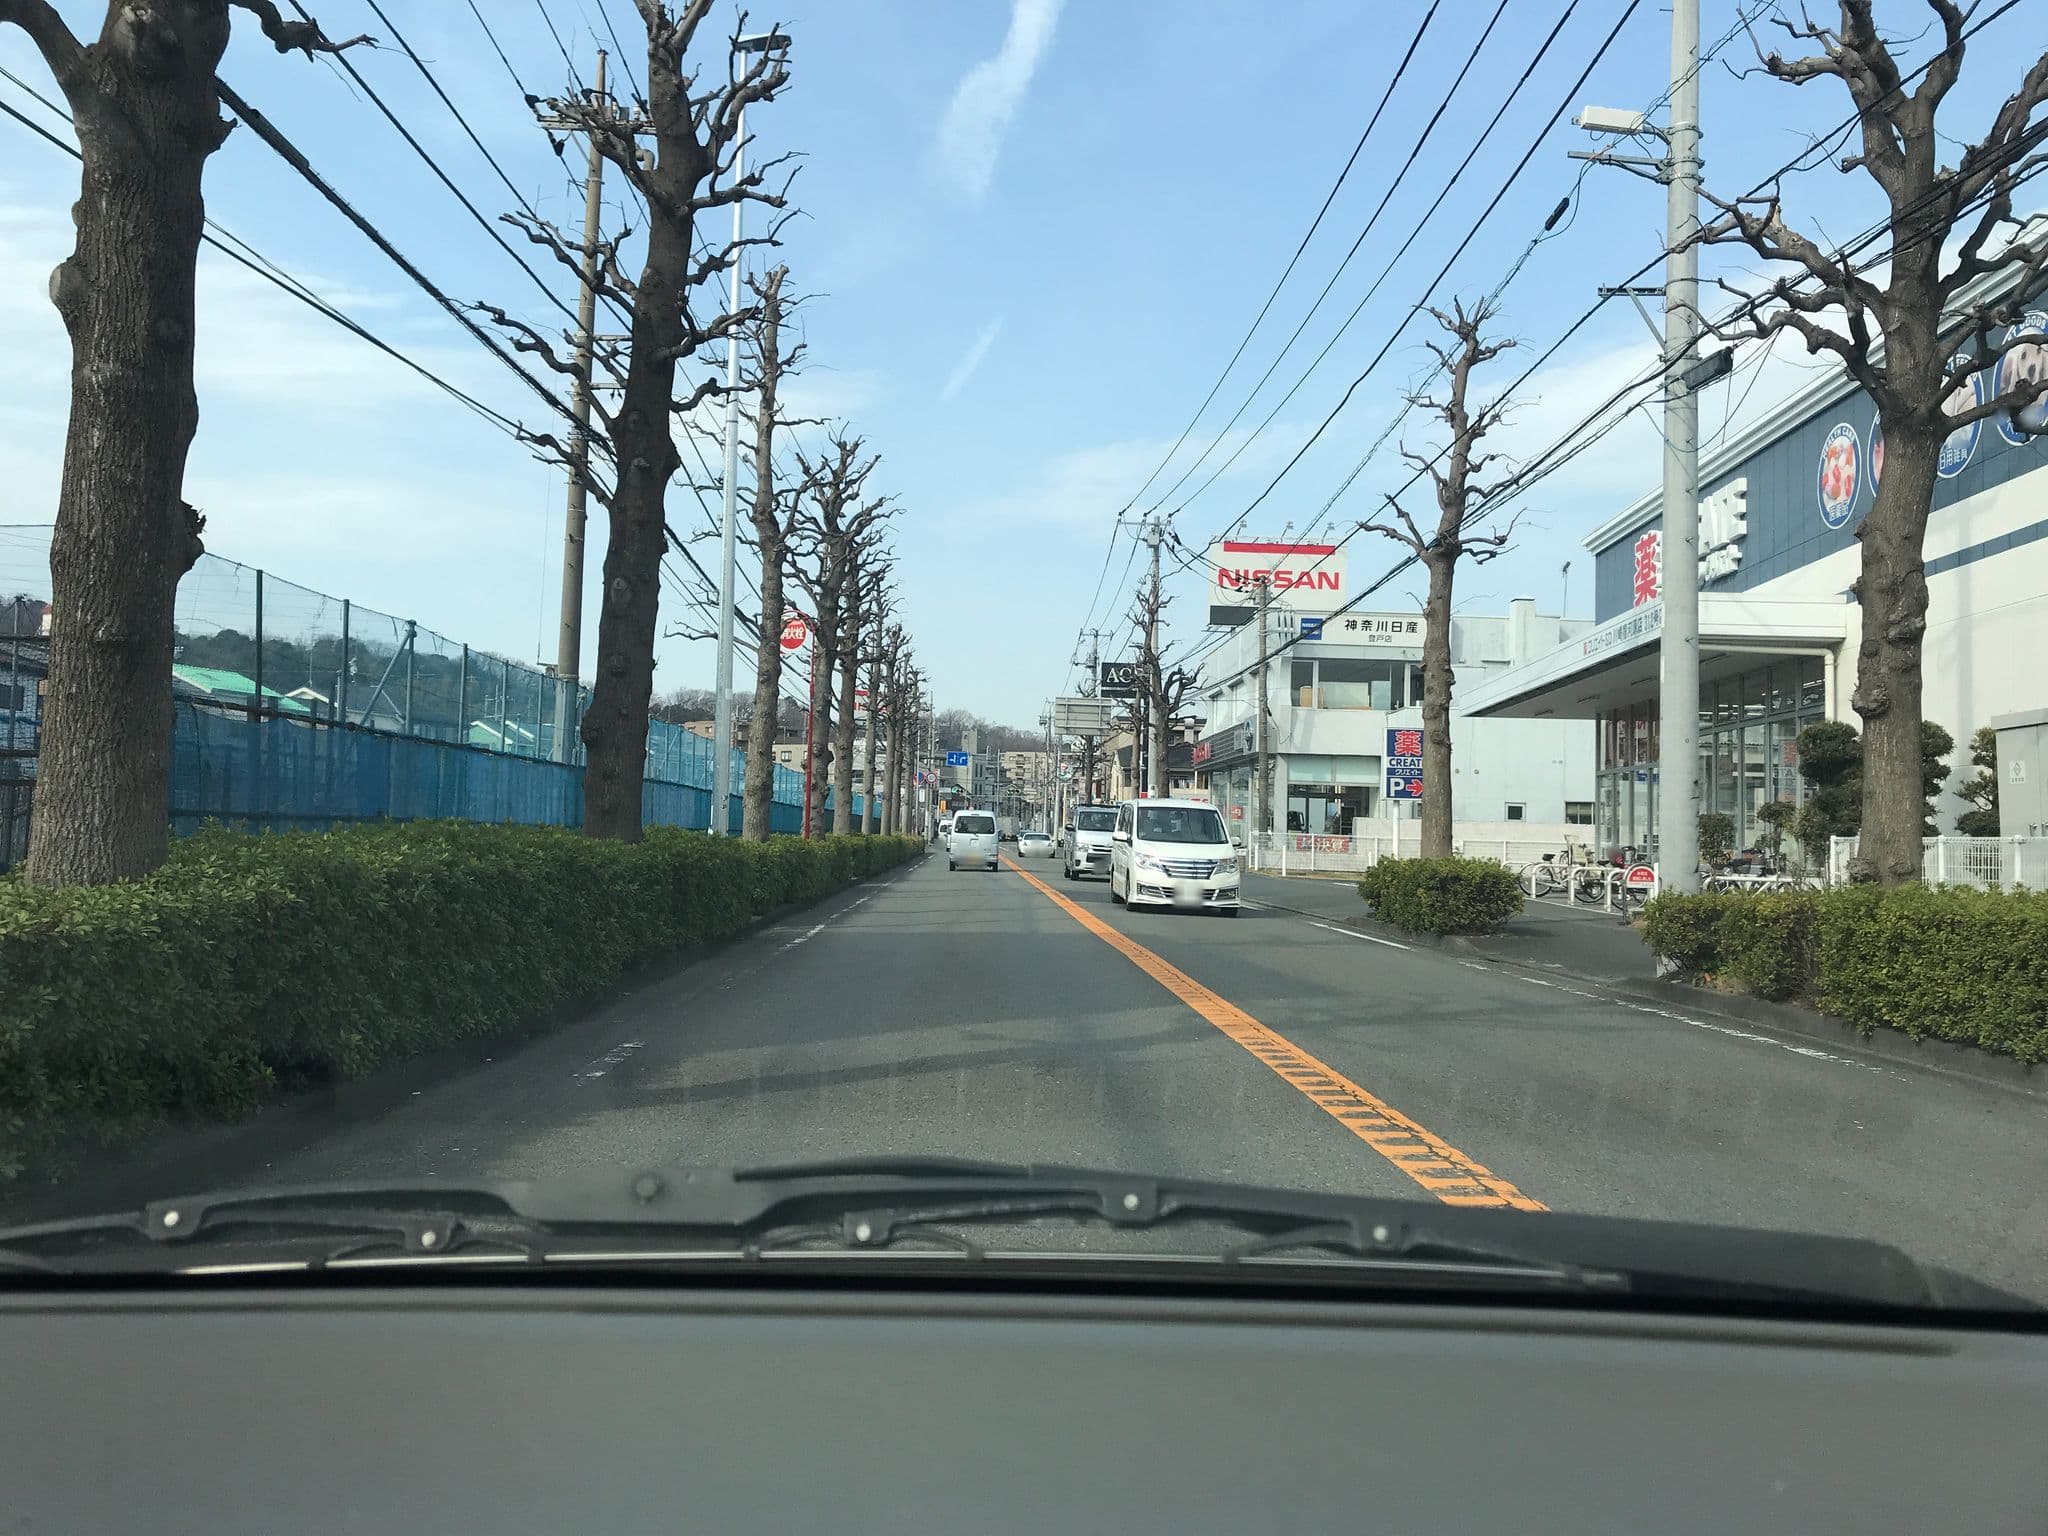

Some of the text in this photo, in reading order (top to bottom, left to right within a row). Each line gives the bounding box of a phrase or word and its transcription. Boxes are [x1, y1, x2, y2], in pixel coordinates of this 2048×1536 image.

[1218, 568, 1339, 590] NISSAN
[1344, 619, 1419, 634] 神奈川日産
[1394, 731, 1422, 756] 薬
[1389, 758, 1422, 768] CREAT
[1390, 777, 1405, 797] P
